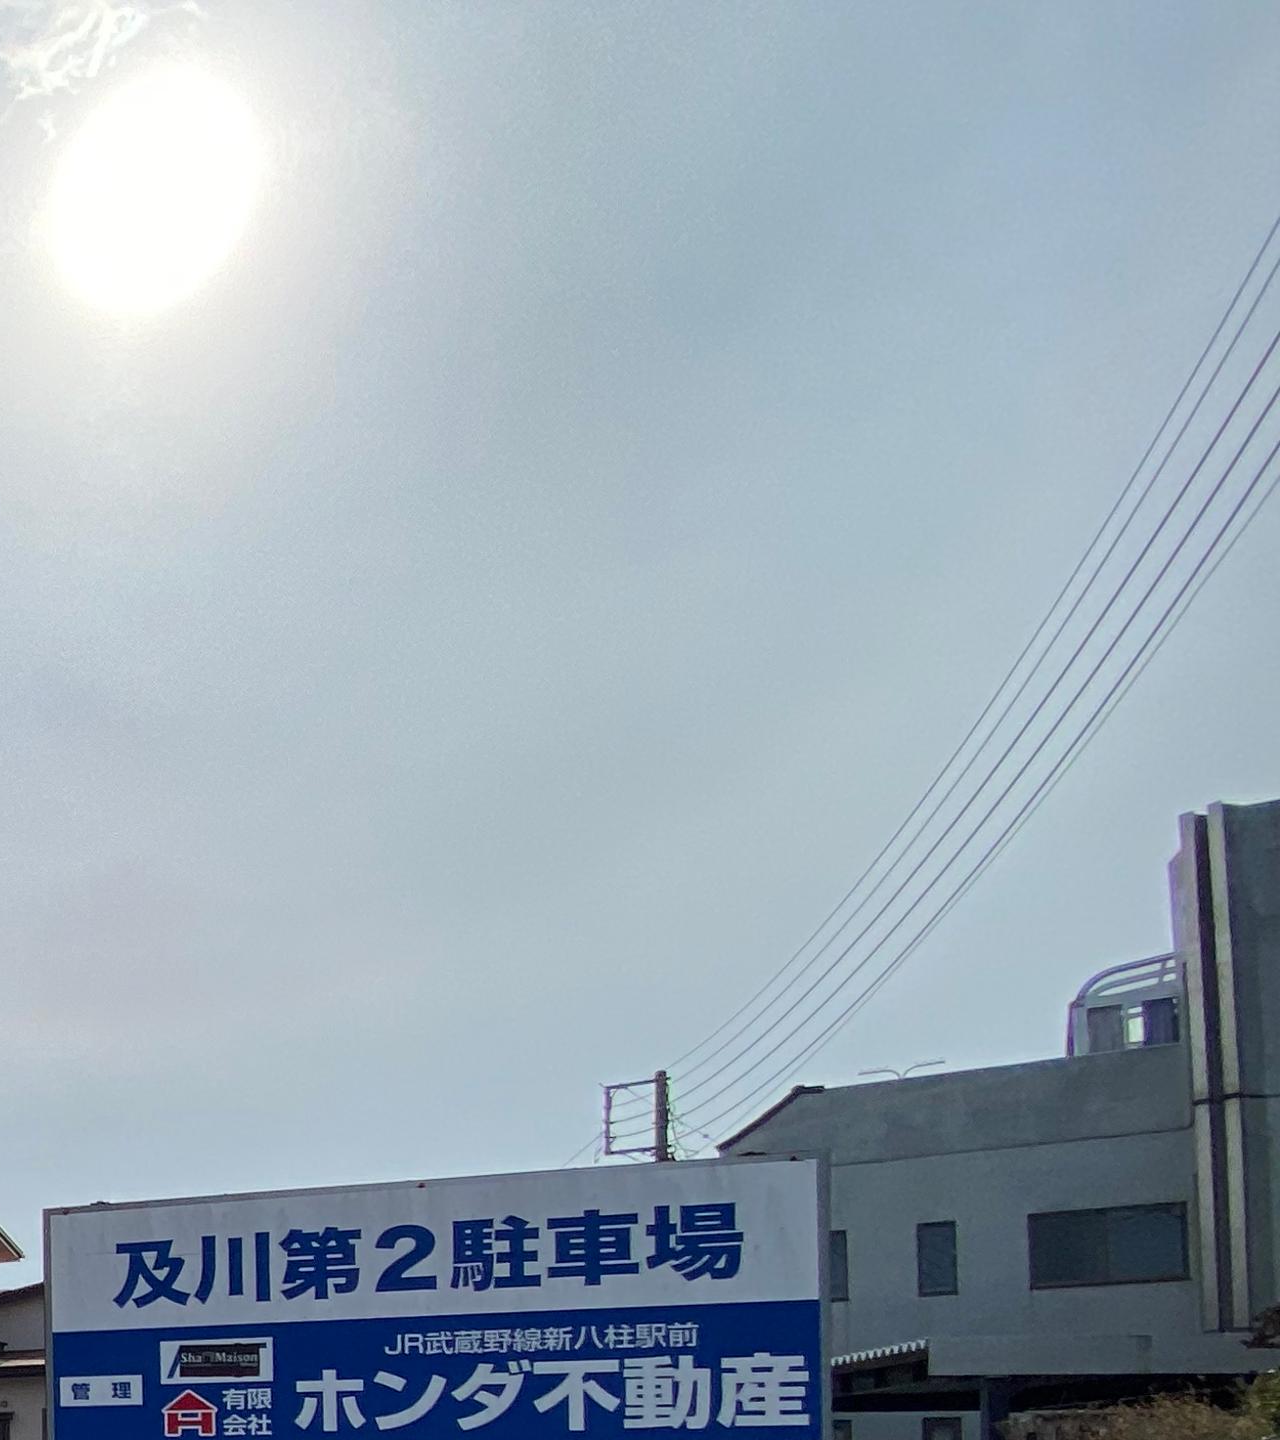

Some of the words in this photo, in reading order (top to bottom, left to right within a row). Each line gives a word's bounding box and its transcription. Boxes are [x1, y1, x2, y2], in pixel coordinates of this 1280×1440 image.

[112, 1203, 745, 1309] 及川第2駐車場
[384, 1321, 700, 1356] JR武蔵野線新八柱駅前
[71, 1381, 132, 1401] 管理
[221, 1387, 273, 1410] 有限
[293, 1351, 811, 1434] ホンダ不動産
[222, 1413, 273, 1436] 会社
